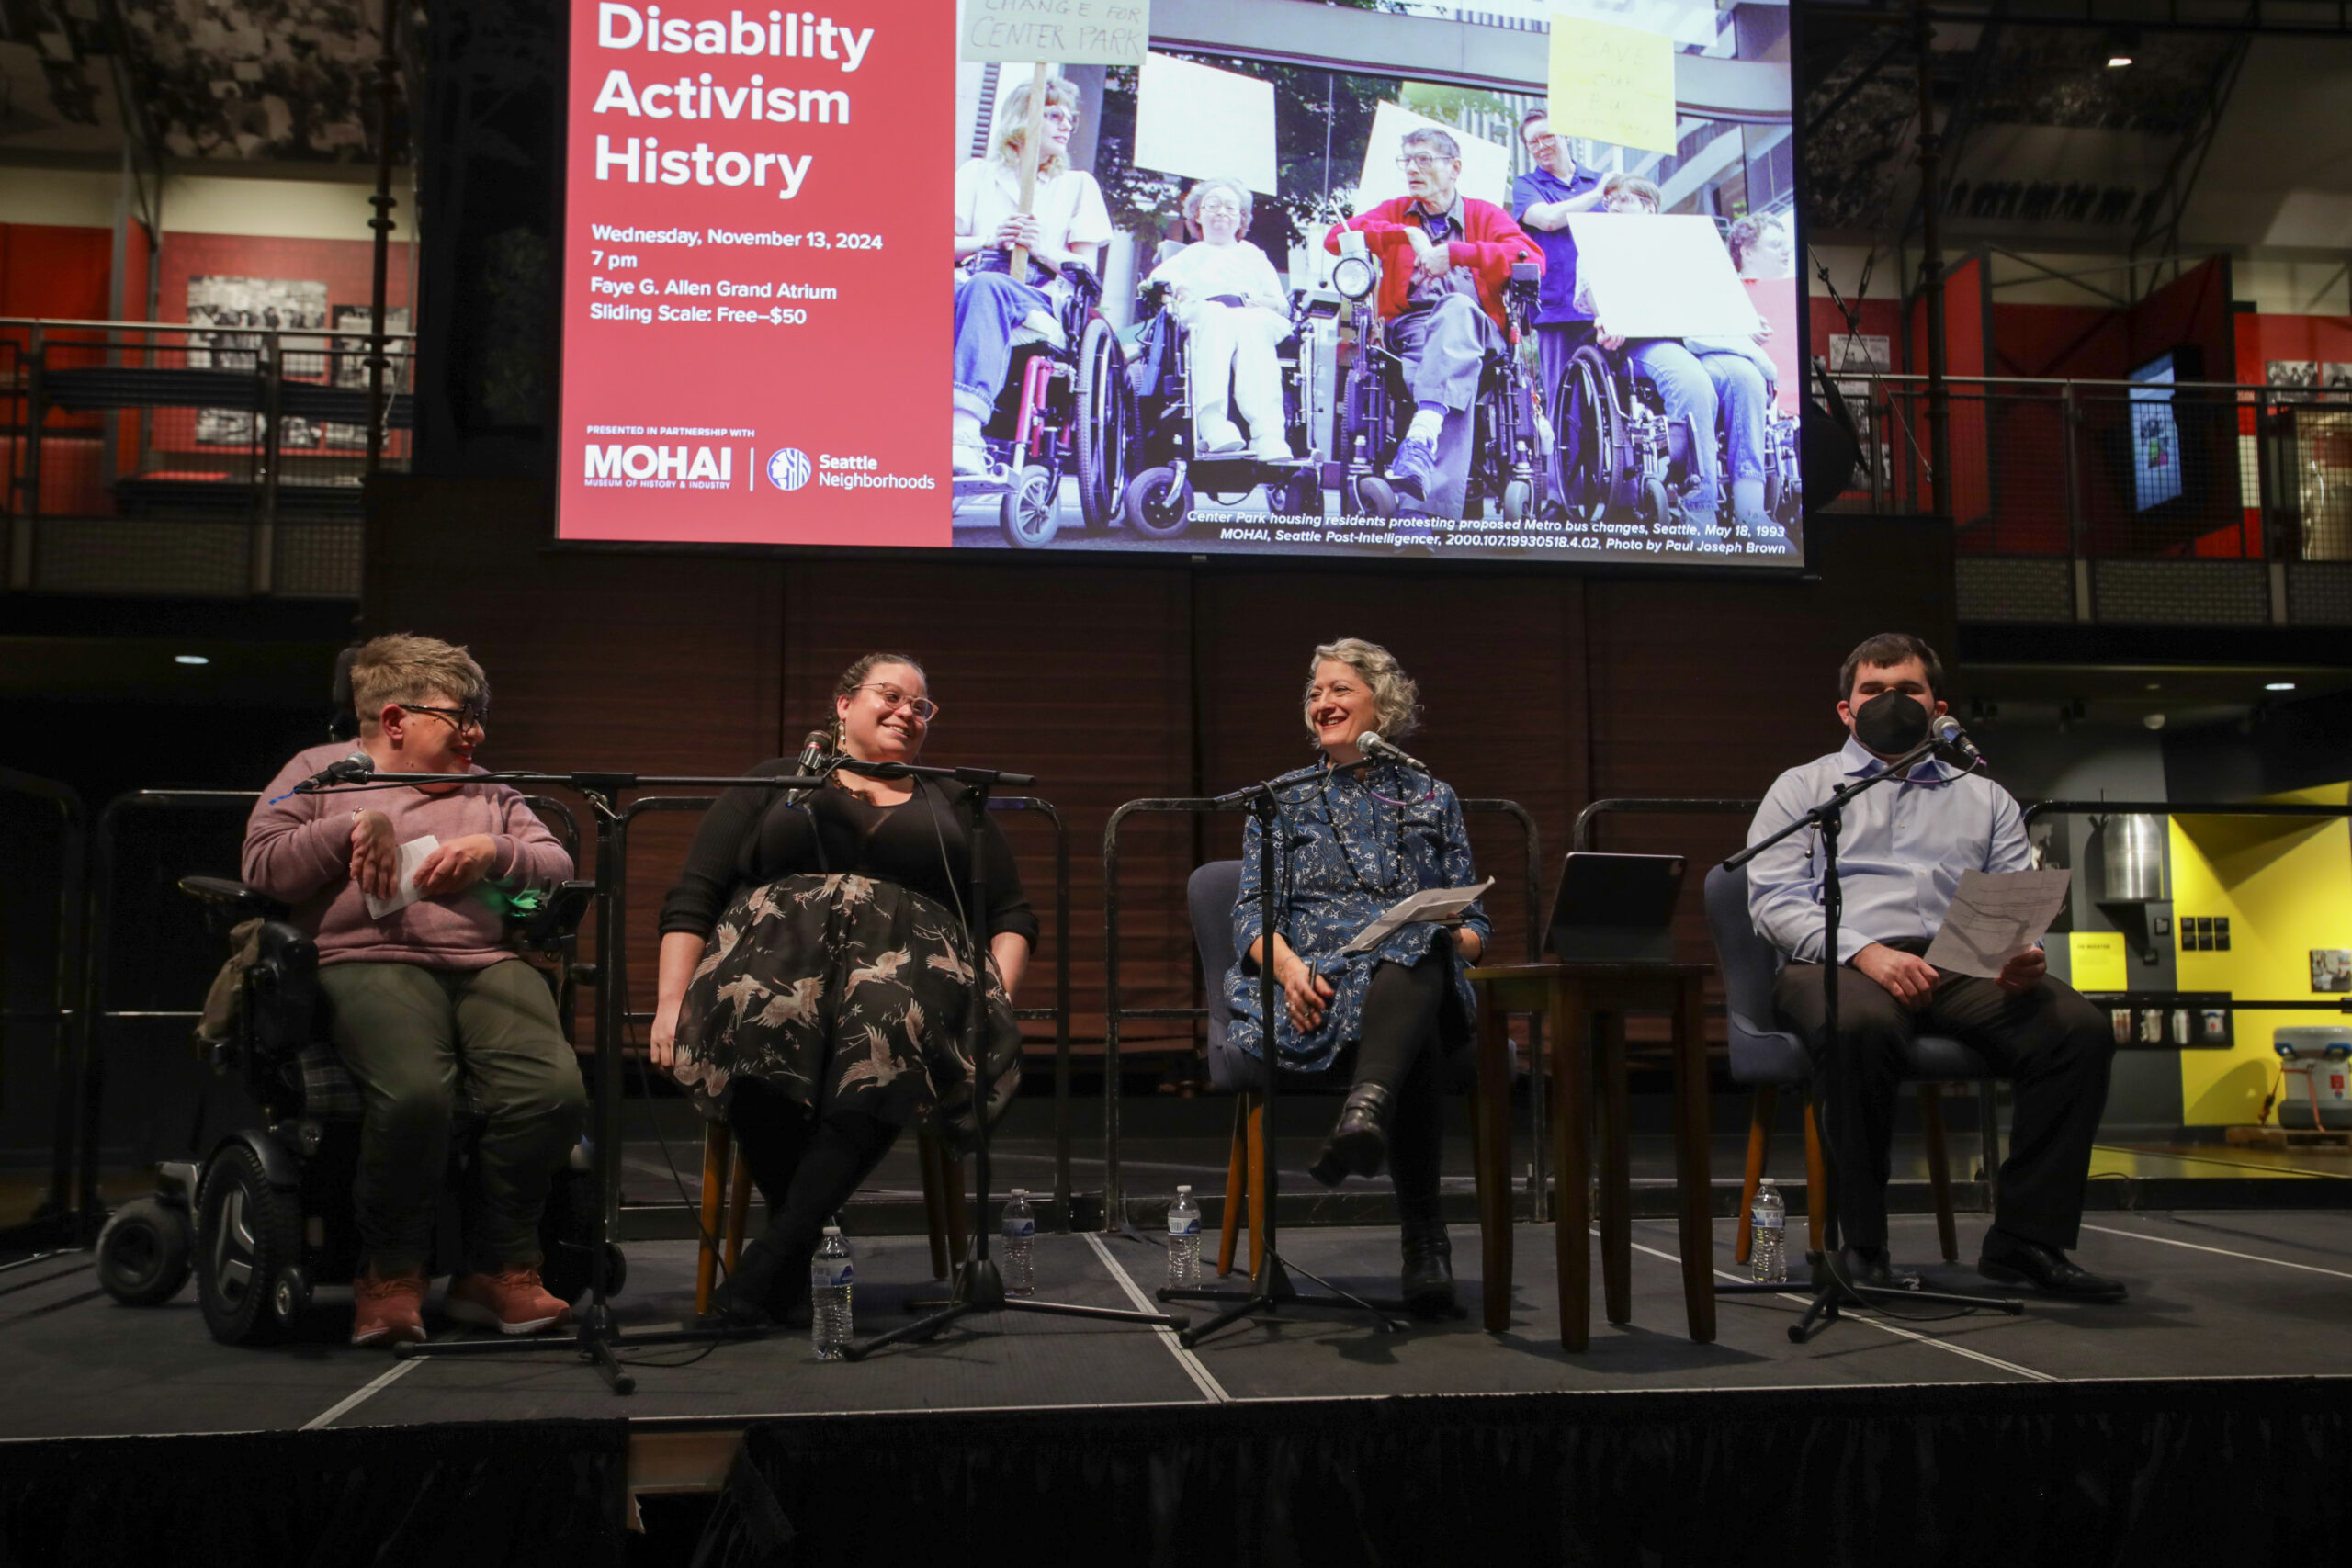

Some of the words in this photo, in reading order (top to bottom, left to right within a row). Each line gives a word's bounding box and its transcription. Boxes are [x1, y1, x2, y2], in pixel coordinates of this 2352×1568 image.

[1106, 6, 1142, 24] FOR
[599, 2, 875, 73] Disability
[971, 16, 1065, 51] CENTER
[1080, 27, 1143, 57] PARK
[593, 69, 849, 124] Activism
[596, 135, 812, 199] History
[592, 224, 702, 247] Wednesday,
[708, 229, 802, 246] November
[807, 232, 831, 249] 13,
[836, 233, 883, 249] 2024
[592, 251, 604, 265] 7
[609, 255, 637, 270] pm
[592, 277, 635, 297] Faye
[639, 279, 659, 295] G.
[665, 279, 711, 295] Allen
[717, 281, 772, 298] Grand
[777, 283, 836, 299] Atrium
[591, 303, 652, 324] Sliding
[658, 305, 711, 321] Scale:
[587, 426, 644, 434] PRESENTED
[660, 427, 727, 435] PARTNERSHIP
[585, 445, 731, 480] MOHAI
[820, 454, 877, 470] Seattle
[626, 479, 639, 488] OF
[640, 480, 676, 489] HISTORY
[679, 480, 686, 489] &
[820, 472, 935, 490] Neighborhoods
[1187, 511, 1234, 524] Center
[1236, 513, 1265, 524] Park
[1270, 513, 1321, 527] housing
[1325, 515, 1385, 527] residents
[1389, 516, 1455, 530] protesting
[1459, 518, 1521, 531] proposed
[1524, 520, 1562, 531] Metro
[1565, 521, 1588, 532] bus
[1591, 522, 1649, 536] changes,
[1653, 523, 1701, 536] Seattle,
[1705, 525, 1732, 537] May
[1736, 525, 1751, 537] 18,
[1757, 526, 1785, 537] 1993
[1220, 529, 1271, 542] MOHAI,
[1275, 530, 1321, 542] Seattle
[1326, 532, 1442, 546] Post-Intelligencer,
[1605, 539, 1643, 551] Photo
[1646, 540, 1662, 553] by
[1666, 541, 1693, 551] Paul
[1697, 542, 1742, 555] Joseph
[1746, 543, 1785, 554] Brown
